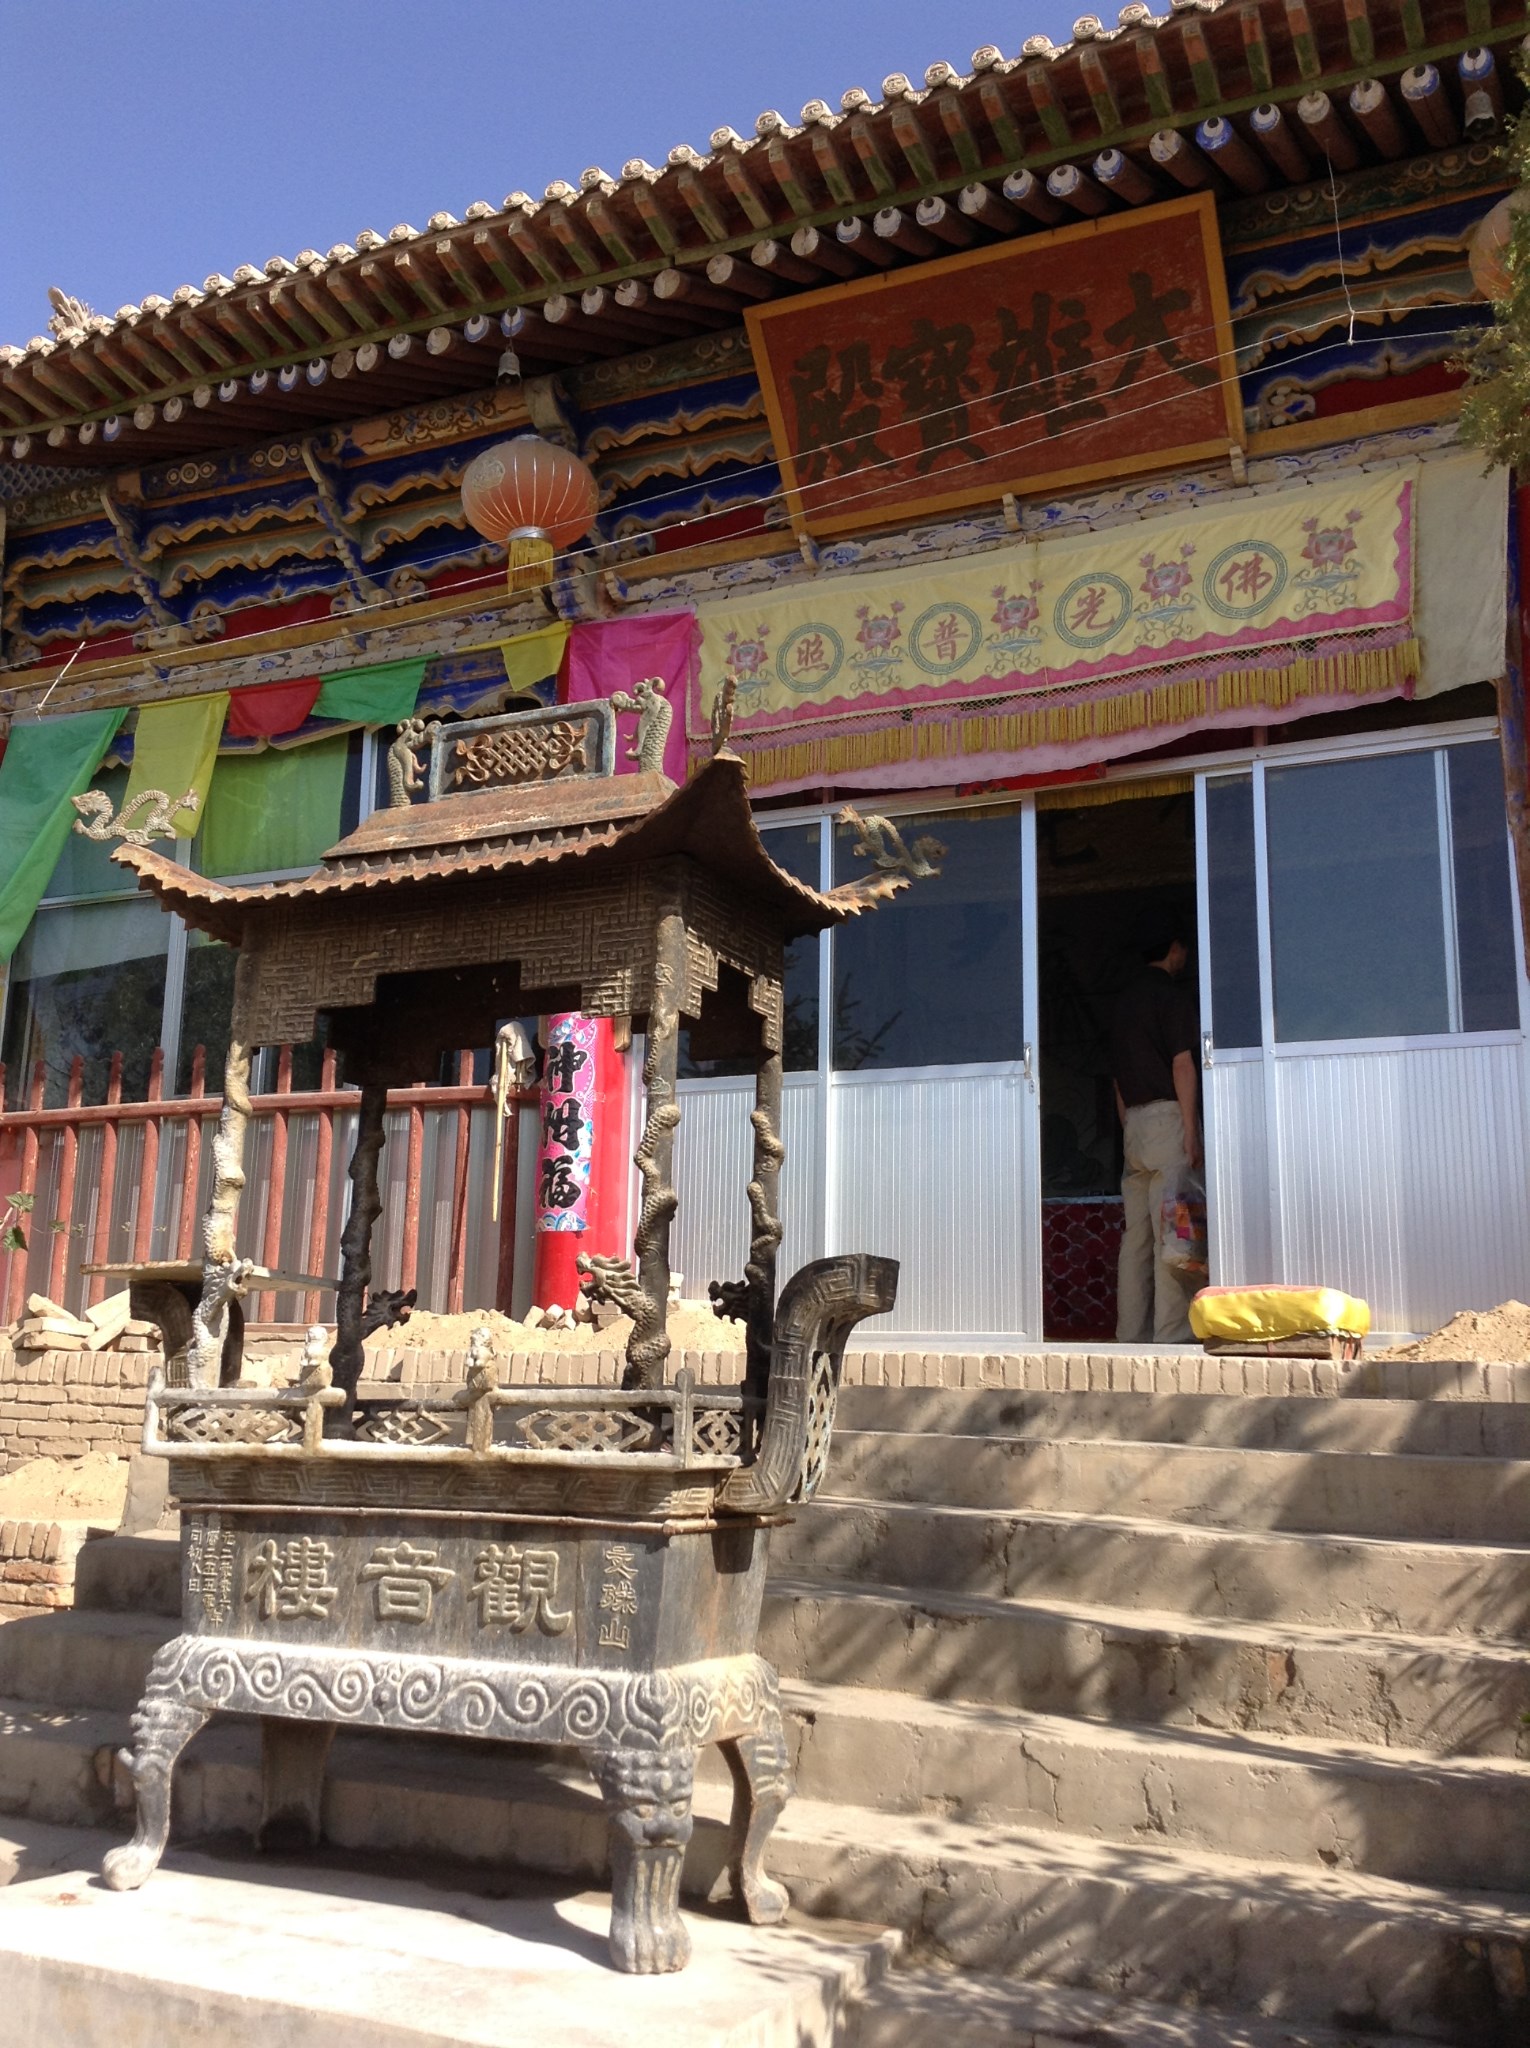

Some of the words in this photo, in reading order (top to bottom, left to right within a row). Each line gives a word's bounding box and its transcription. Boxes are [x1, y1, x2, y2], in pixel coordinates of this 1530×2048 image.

[794, 553, 1273, 676] 佛光普照
[246, 1536, 572, 1636] 觀音樓
